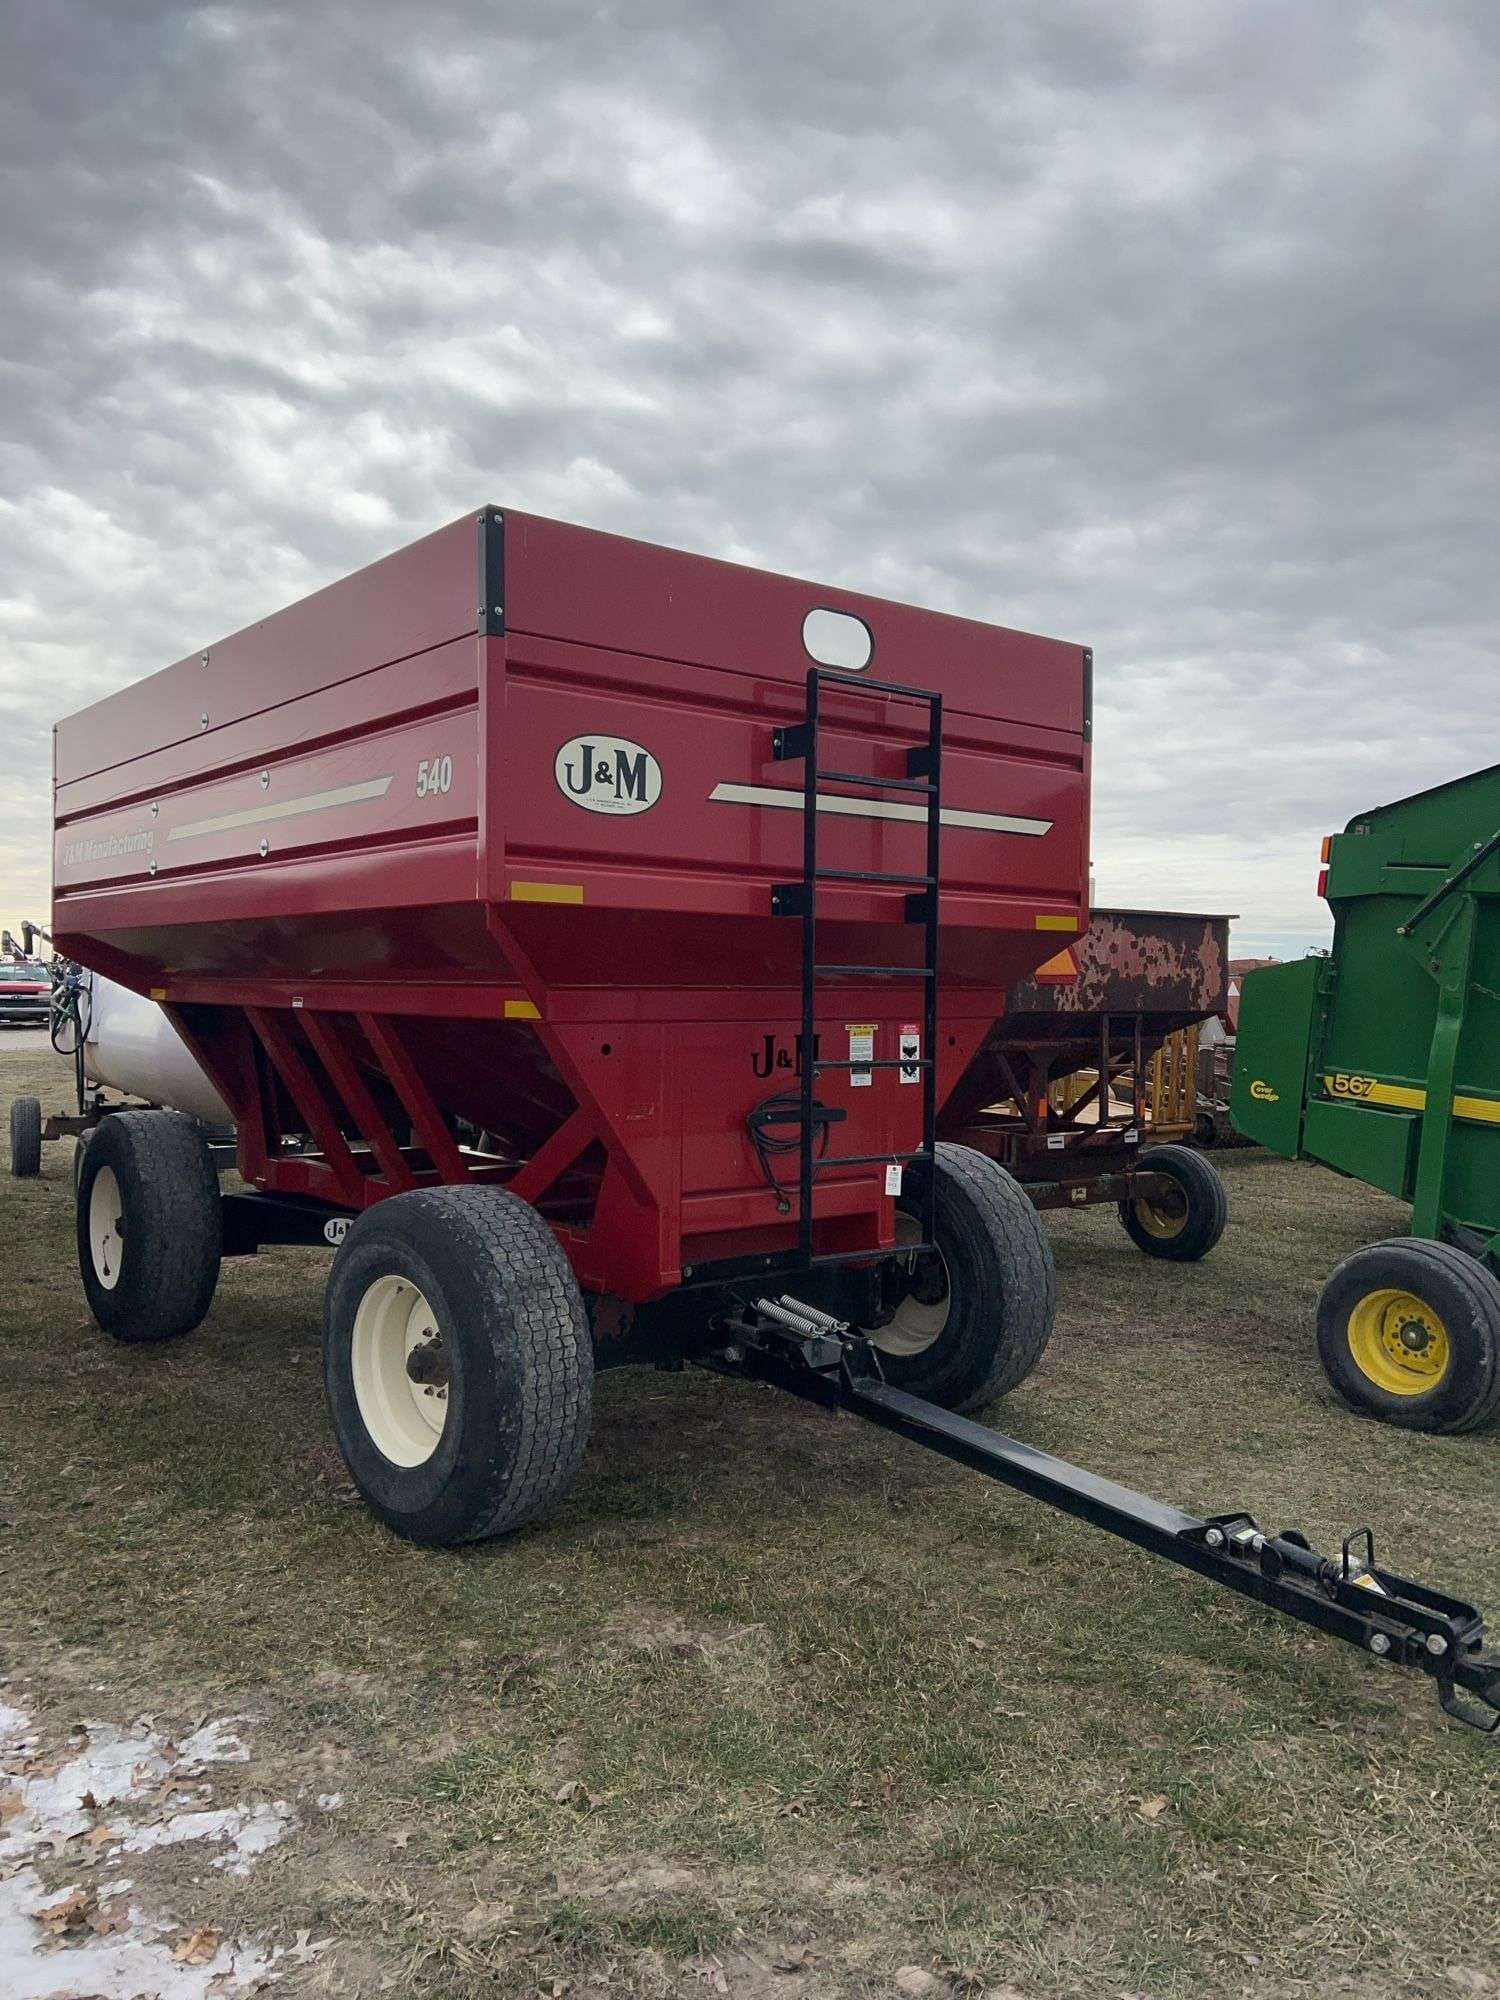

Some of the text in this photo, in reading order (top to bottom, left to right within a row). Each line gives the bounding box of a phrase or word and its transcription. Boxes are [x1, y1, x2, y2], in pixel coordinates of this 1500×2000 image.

[416, 755, 453, 798] 540
[564, 744, 649, 802] J&M
[1333, 1073, 1378, 1097] 567
[327, 1221, 351, 1239] J&
